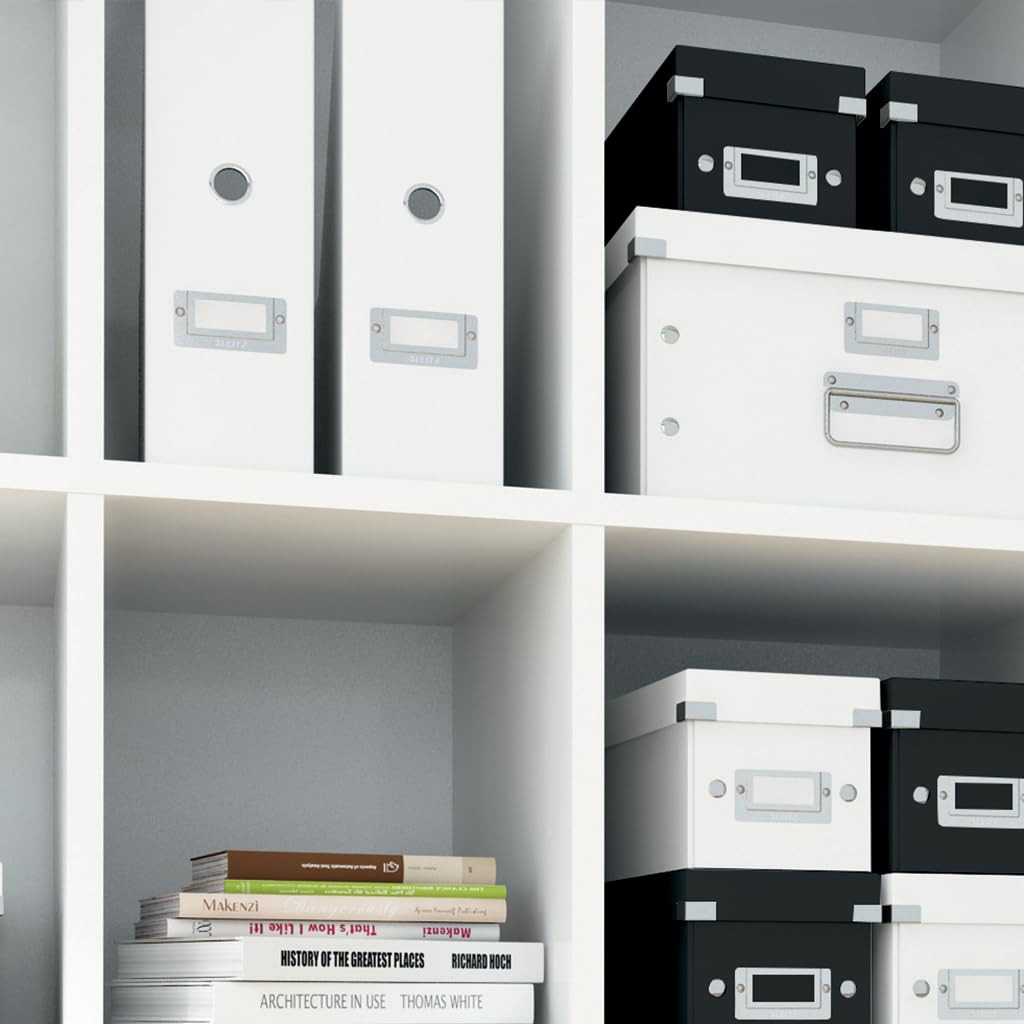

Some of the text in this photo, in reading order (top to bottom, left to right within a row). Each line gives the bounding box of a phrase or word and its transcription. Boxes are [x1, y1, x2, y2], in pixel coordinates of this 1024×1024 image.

[249, 923, 377, 936] That's How I Like It!
[422, 927, 471, 938] Makenzi
[280, 951, 425, 968] HISTORY OF THE GREATEST PLACES
[452, 954, 512, 970] RICHARD HOCH
[260, 994, 386, 1010] ARCHITECTURE IN USE
[400, 994, 483, 1010] THOMAS WHITE
